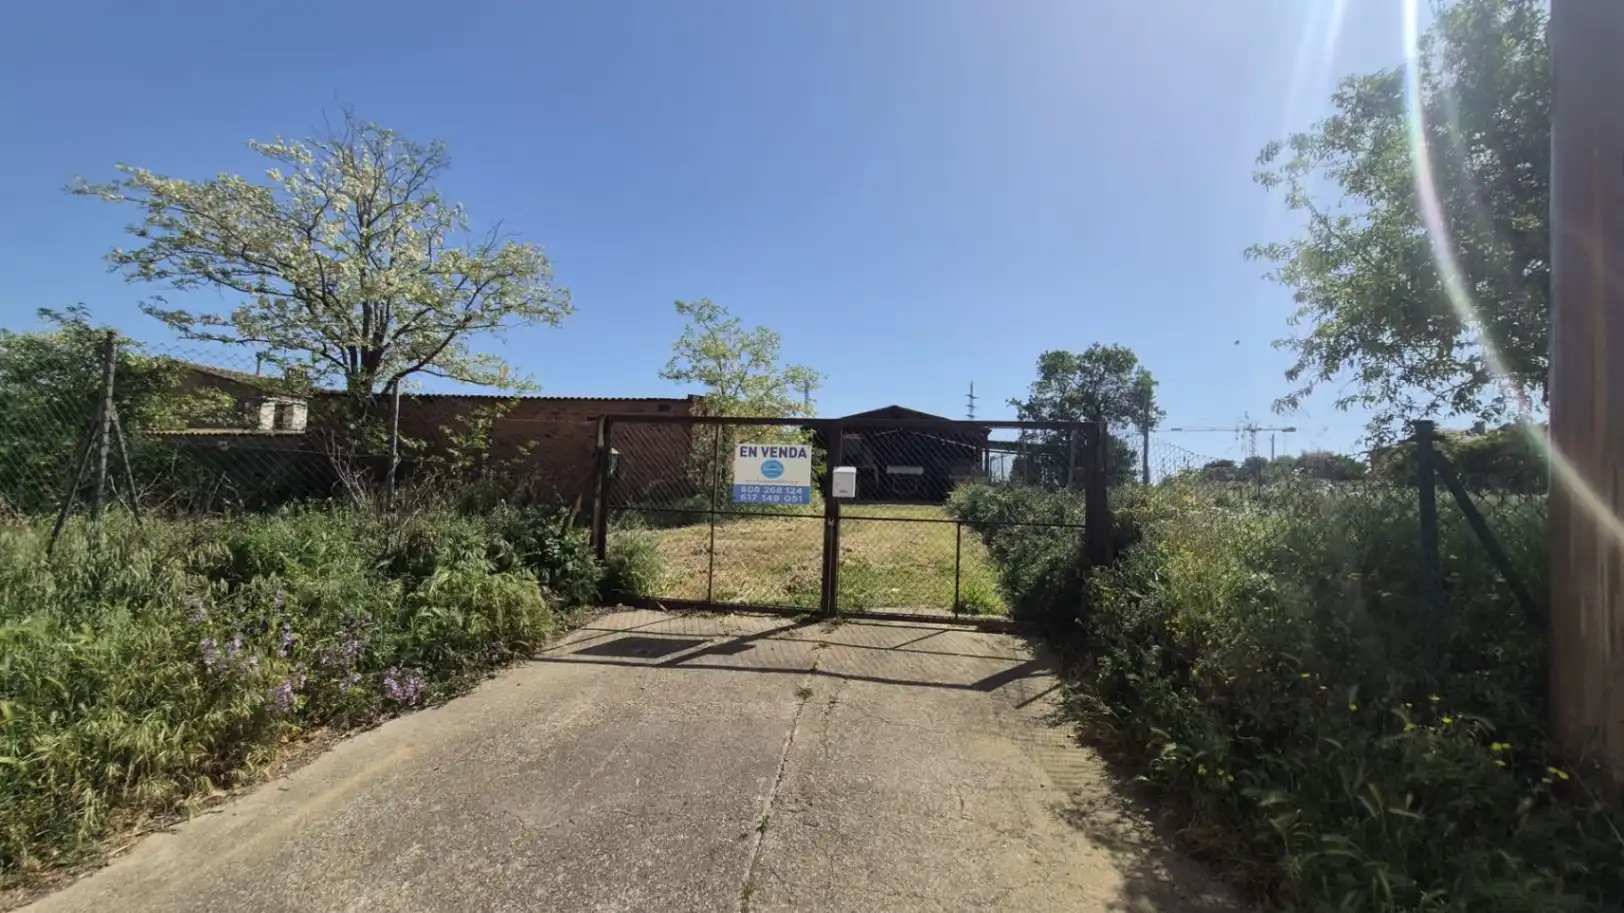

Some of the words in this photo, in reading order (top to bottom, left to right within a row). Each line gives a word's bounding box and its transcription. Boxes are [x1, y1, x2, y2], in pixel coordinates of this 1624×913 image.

[740, 446, 757, 458] EN
[761, 446, 807, 459] VENDA
[740, 494, 757, 502] 617
